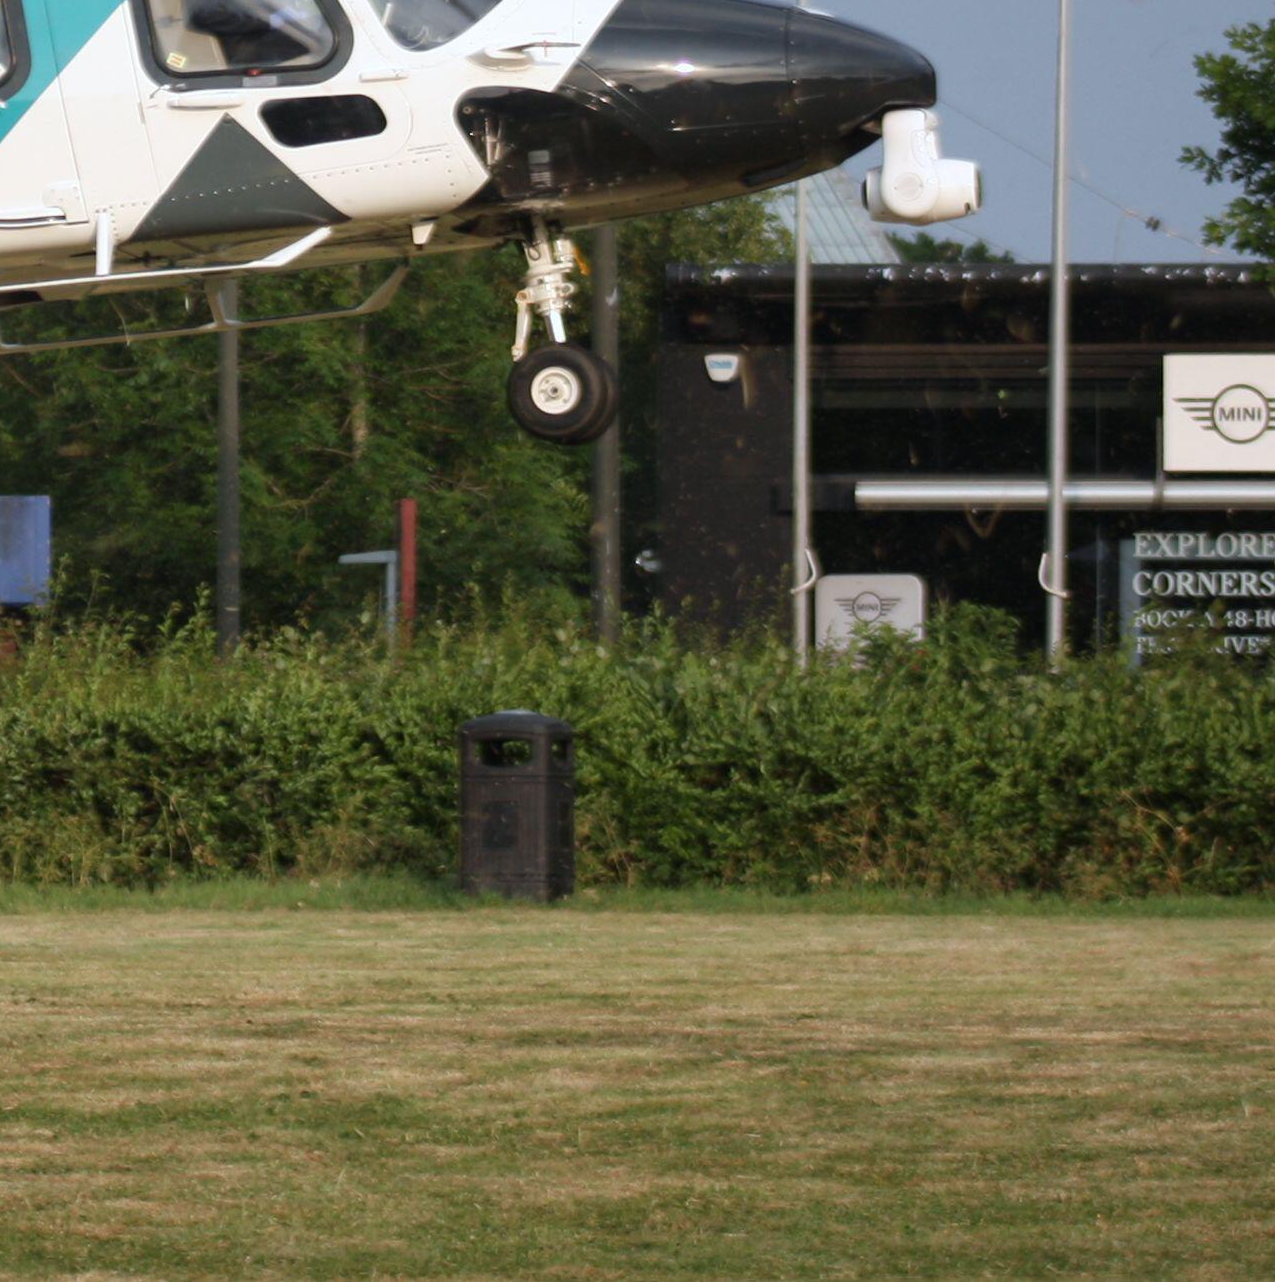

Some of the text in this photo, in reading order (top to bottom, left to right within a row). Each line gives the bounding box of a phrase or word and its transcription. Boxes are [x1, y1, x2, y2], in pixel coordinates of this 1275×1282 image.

[1218, 406, 1262, 422] MINI
[1132, 532, 1275, 558] EXPLORE
[1132, 571, 1275, 596] CORNERS
[856, 603, 879, 612] MINI
